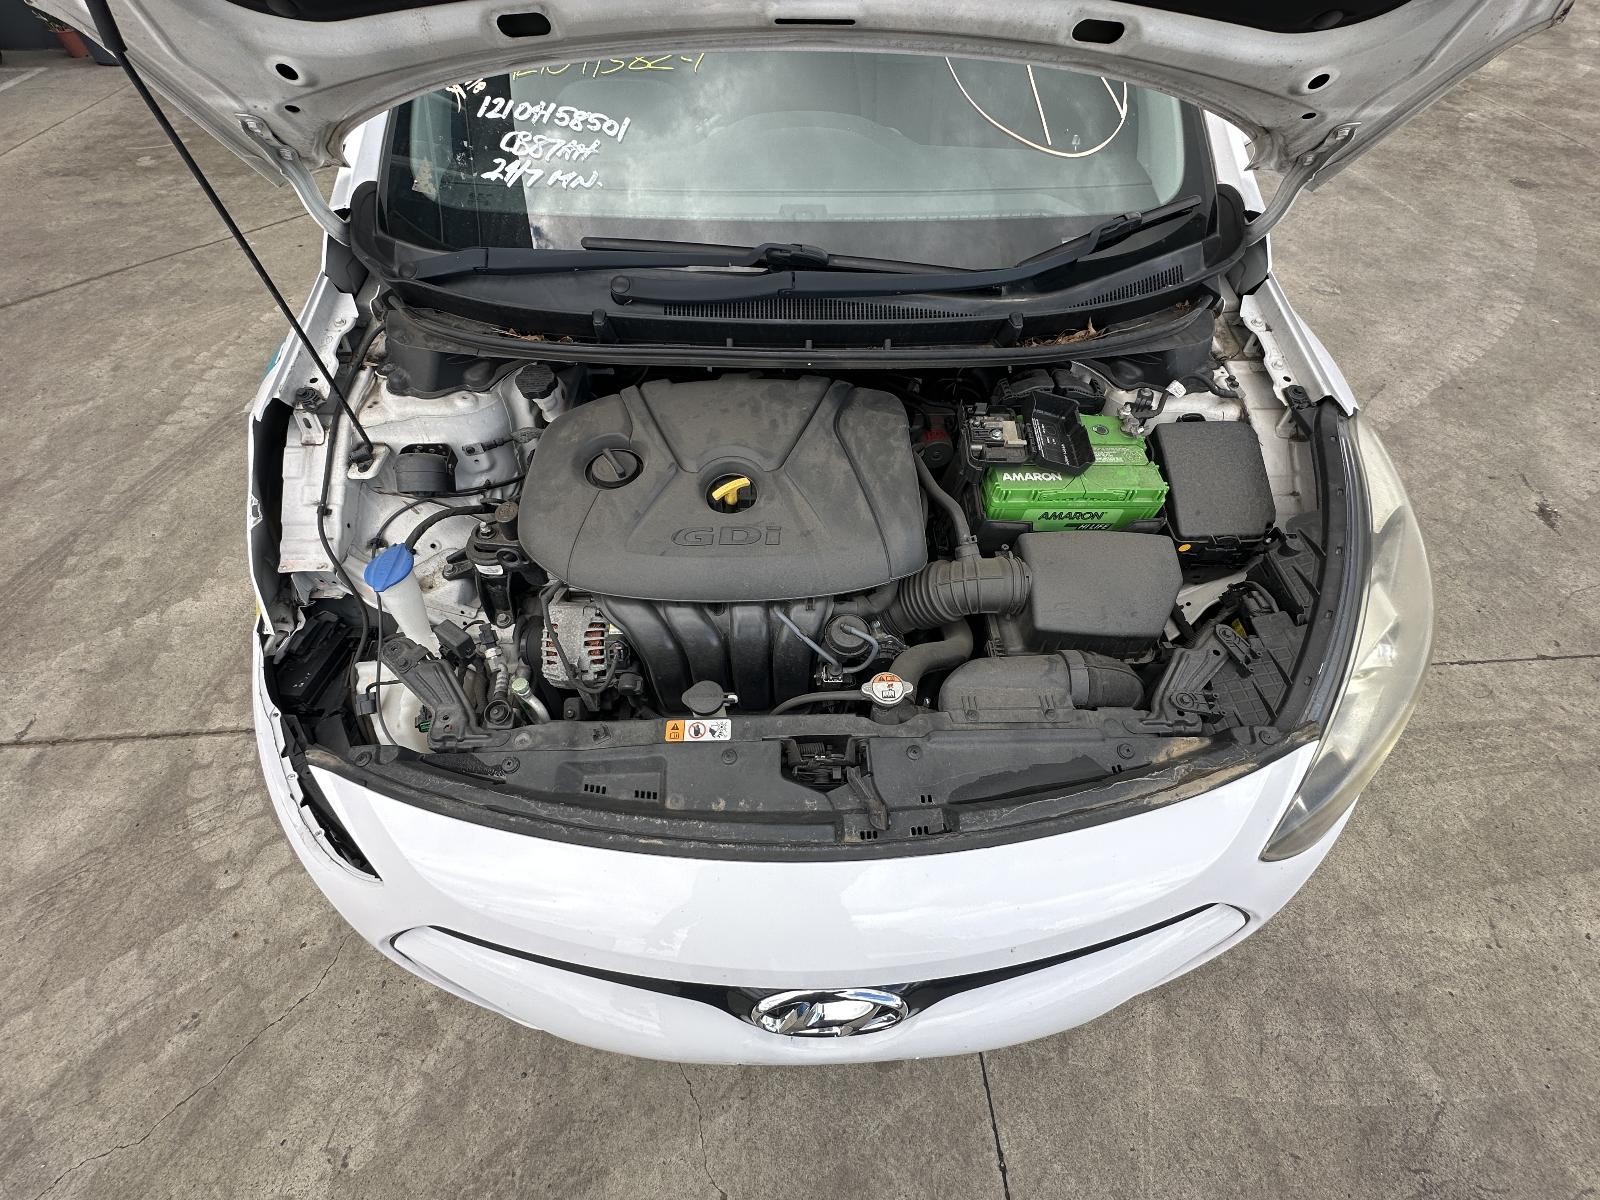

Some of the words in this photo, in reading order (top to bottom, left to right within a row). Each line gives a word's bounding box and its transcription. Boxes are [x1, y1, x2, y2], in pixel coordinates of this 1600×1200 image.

[1003, 472, 1062, 481] AMARON
[1038, 511, 1104, 520] AMARON
[671, 526, 782, 546] GDi
